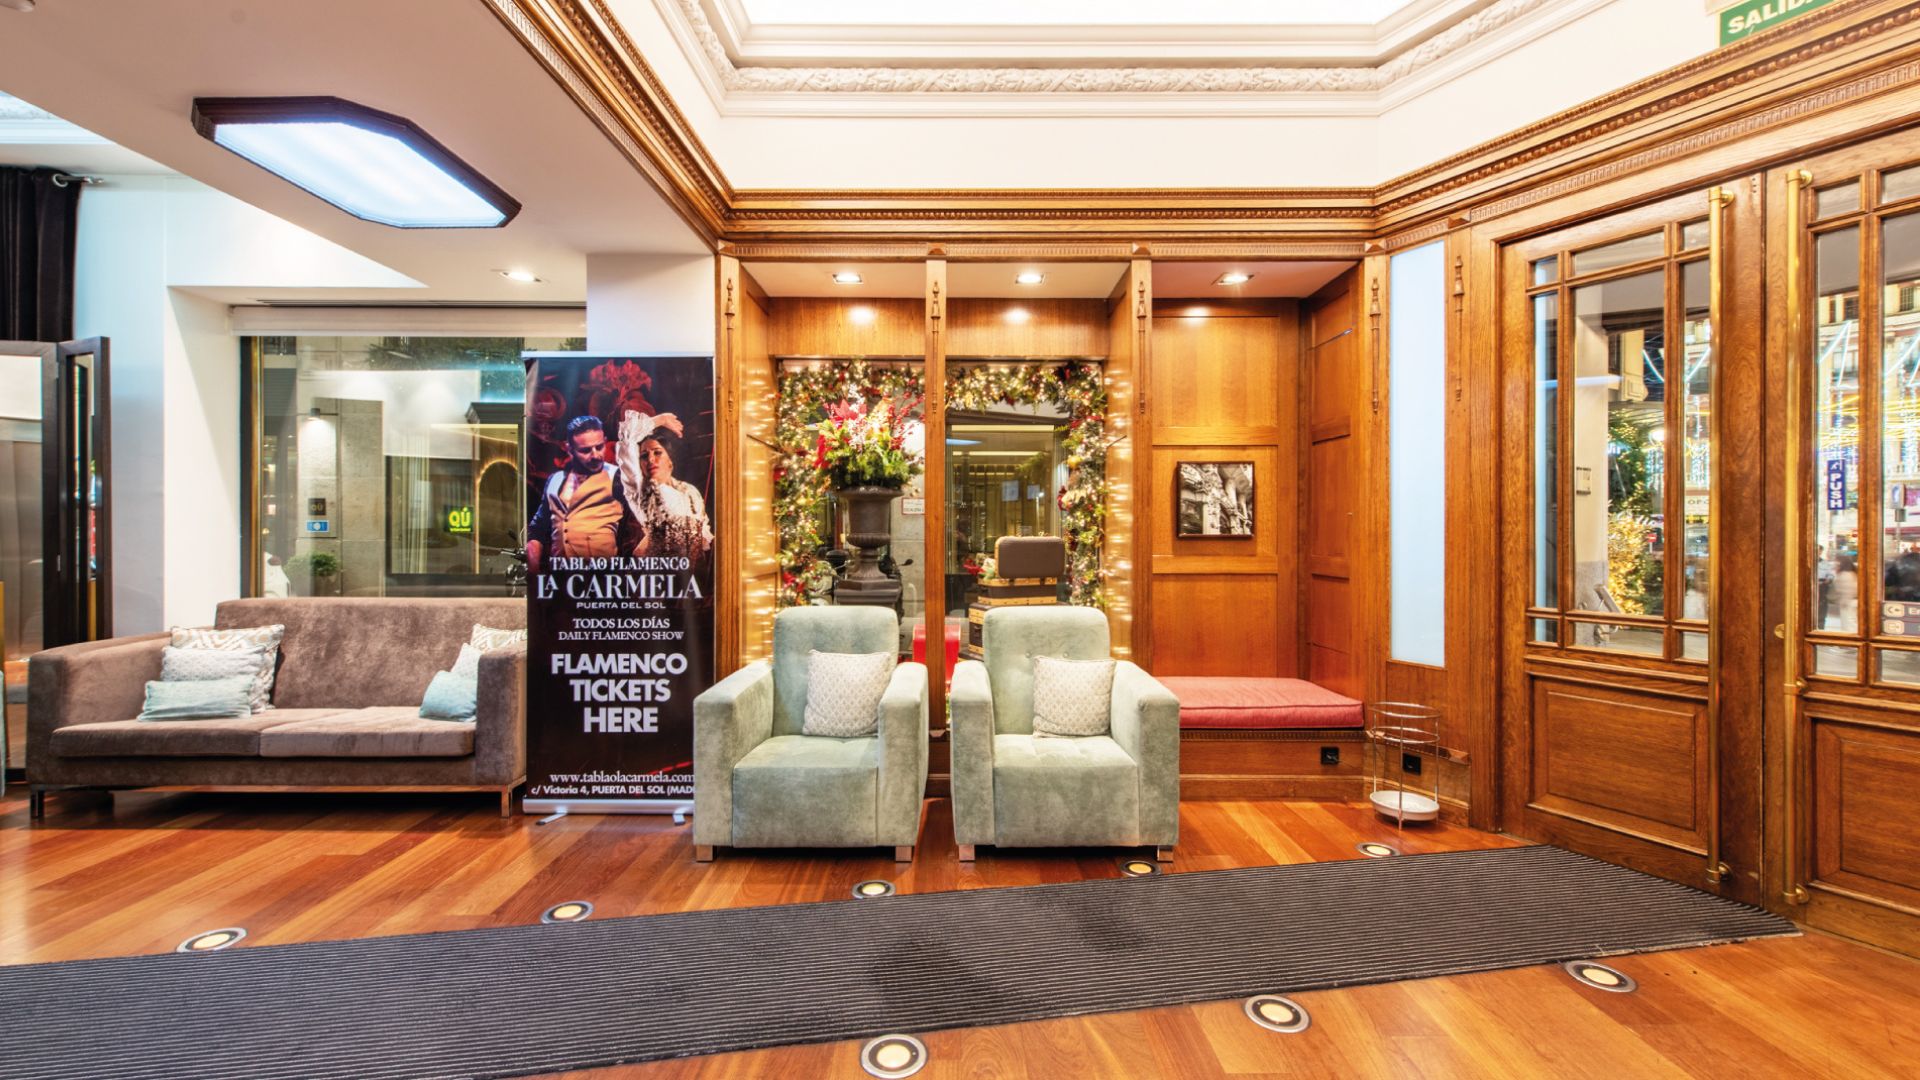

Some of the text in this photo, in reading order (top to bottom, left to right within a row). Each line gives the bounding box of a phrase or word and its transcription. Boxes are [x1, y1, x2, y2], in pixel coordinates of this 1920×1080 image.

[1727, 0, 1813, 34] SALI
[1830, 472, 1843, 508] PUSH
[550, 556, 690, 571] TABLAO FLAMENCO
[537, 574, 704, 599] LA CARMELA
[572, 616, 671, 629] TODOS LOS DÍAS
[558, 631, 684, 640] DAILY FLAMENCO SHOW
[551, 652, 688, 675] FLAMENCO
[569, 678, 671, 702] TICKETS
[583, 707, 659, 733] HERE
[549, 770, 695, 783] www.tablaolacarmela.com
[531, 785, 541, 795] c/
[543, 785, 579, 794] Victoria
[580, 785, 590, 796] 4,
[591, 785, 627, 794] PUERTA
[628, 785, 645, 794] DEL
[646, 785, 666, 794] SOL
